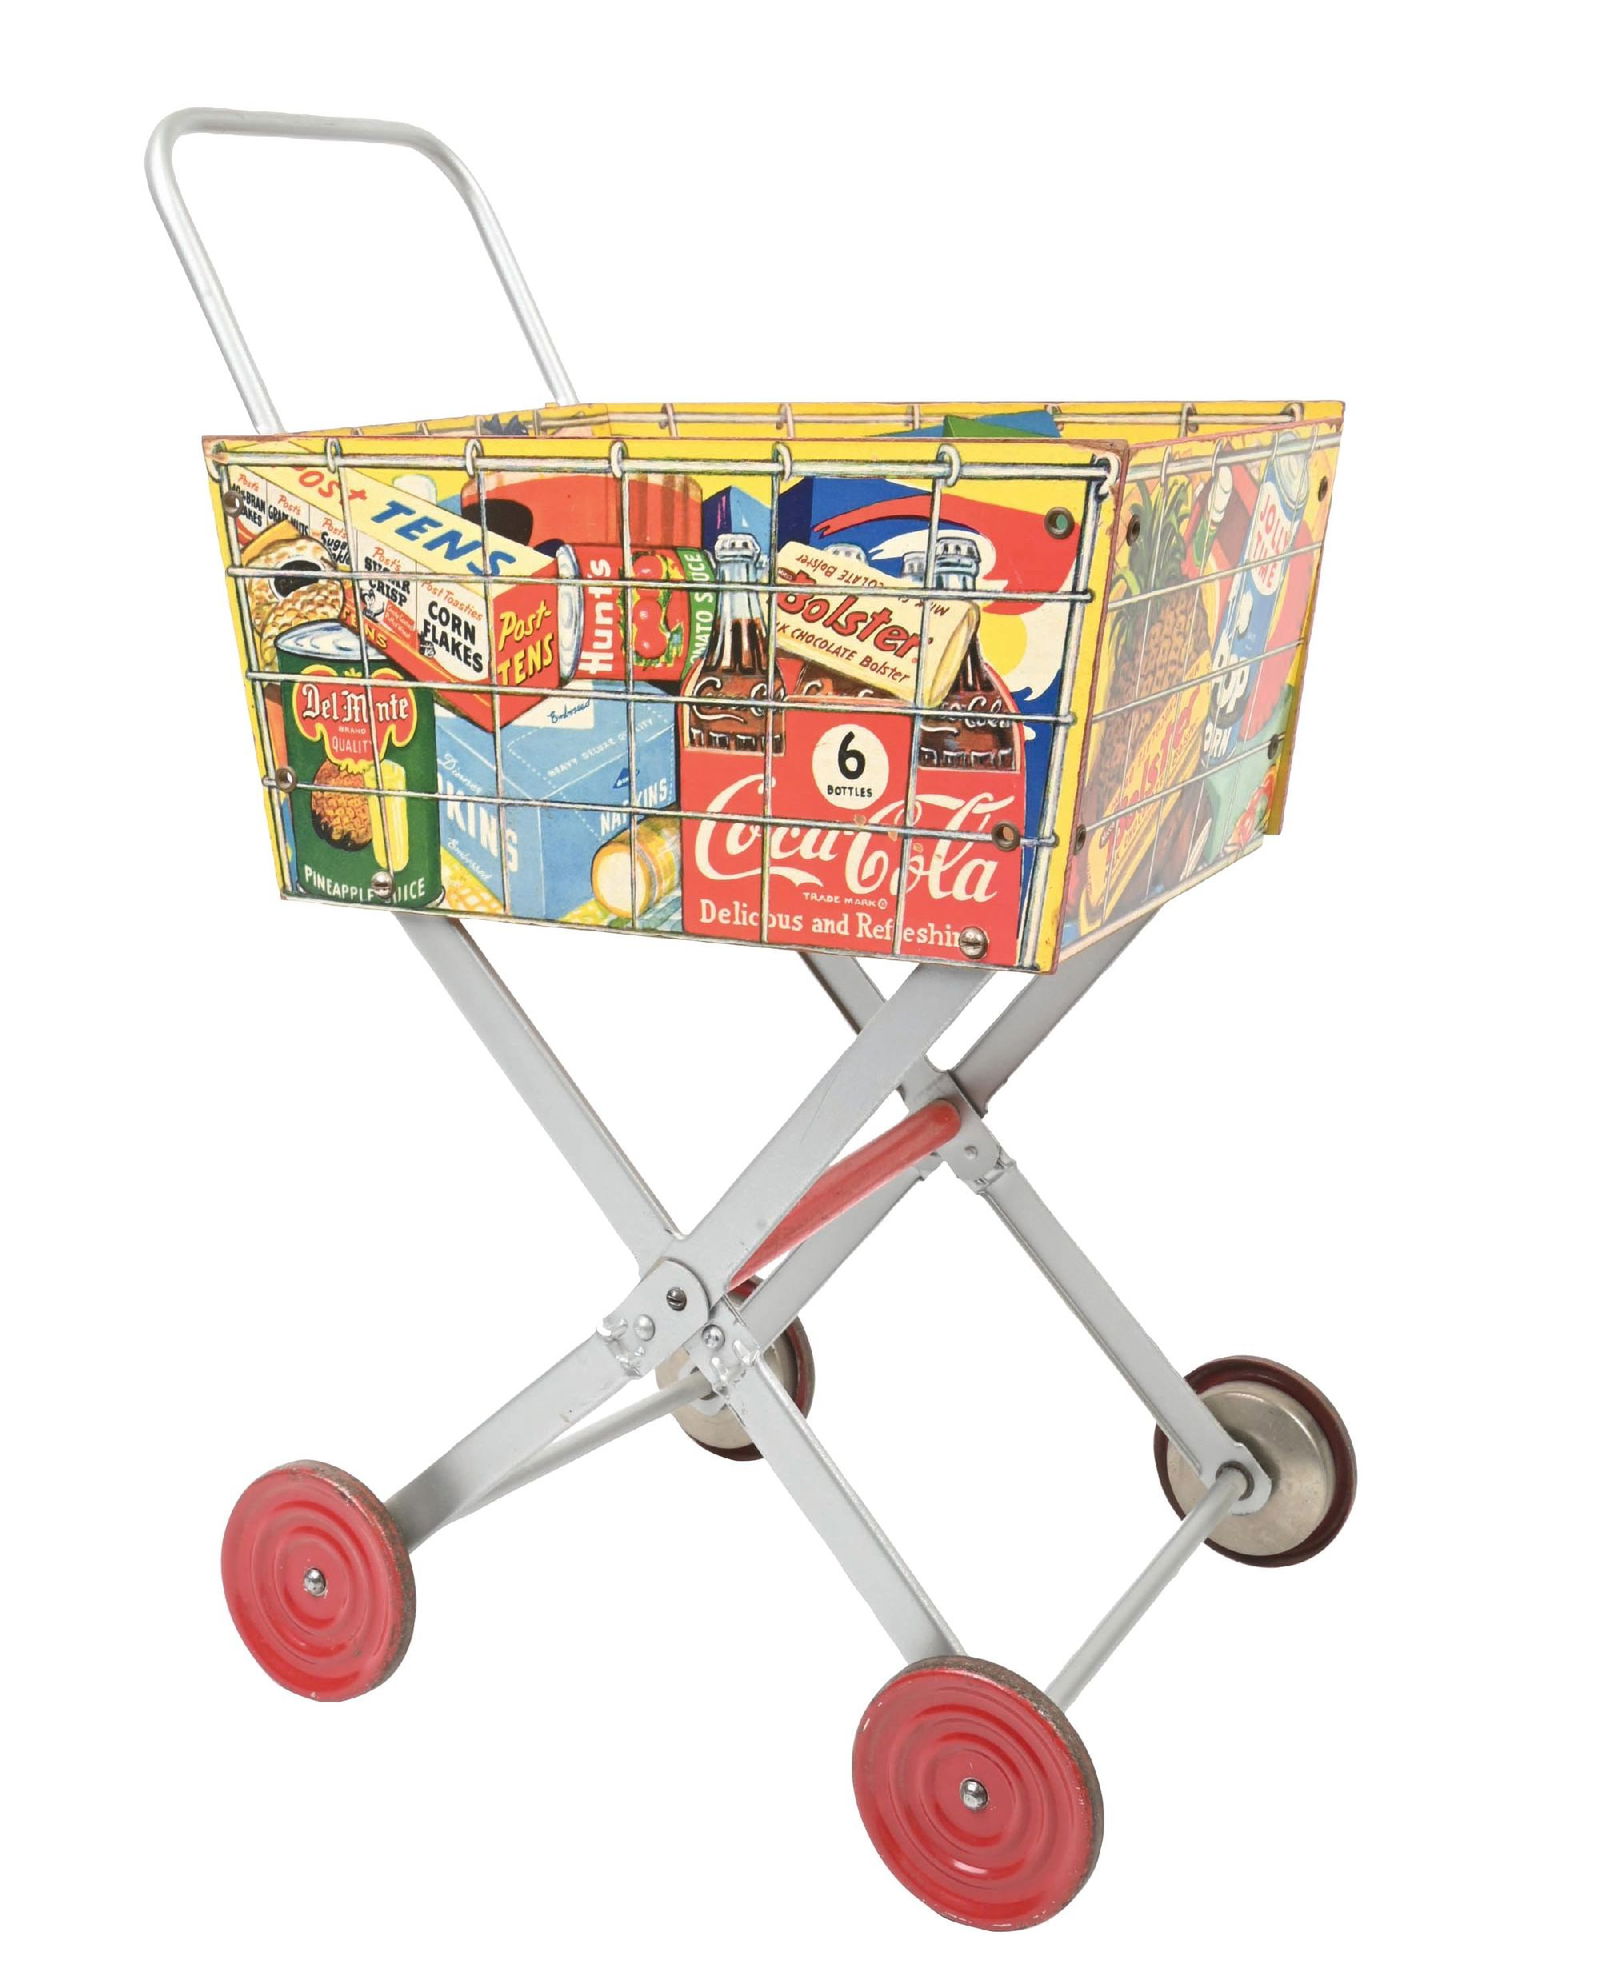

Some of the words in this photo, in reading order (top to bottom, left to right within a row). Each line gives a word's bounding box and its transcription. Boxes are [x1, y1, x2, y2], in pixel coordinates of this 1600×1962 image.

[240, 504, 262, 527] AKES
[270, 463, 367, 506] ost
[371, 500, 516, 576] TENS
[321, 531, 349, 551] Suga
[684, 553, 714, 603] SUCE
[428, 600, 475, 645] CORN
[578, 559, 614, 674] Hunt's
[423, 618, 483, 673] FLAKES
[497, 632, 552, 686] TENS
[790, 627, 858, 662] CHOCOLATE
[859, 655, 911, 684] Bolster
[302, 684, 339, 719] Del
[341, 690, 409, 723] Mnte
[838, 731, 865, 779] 6
[600, 777, 668, 836] NAINS
[827, 785, 873, 798] BOTTLES
[437, 771, 518, 873] KINS
[384, 877, 425, 904] UICE
[803, 891, 840, 905] TRADE
[700, 898, 804, 932] Delicous
[811, 914, 850, 936] and
[856, 912, 989, 949] Refeshi
